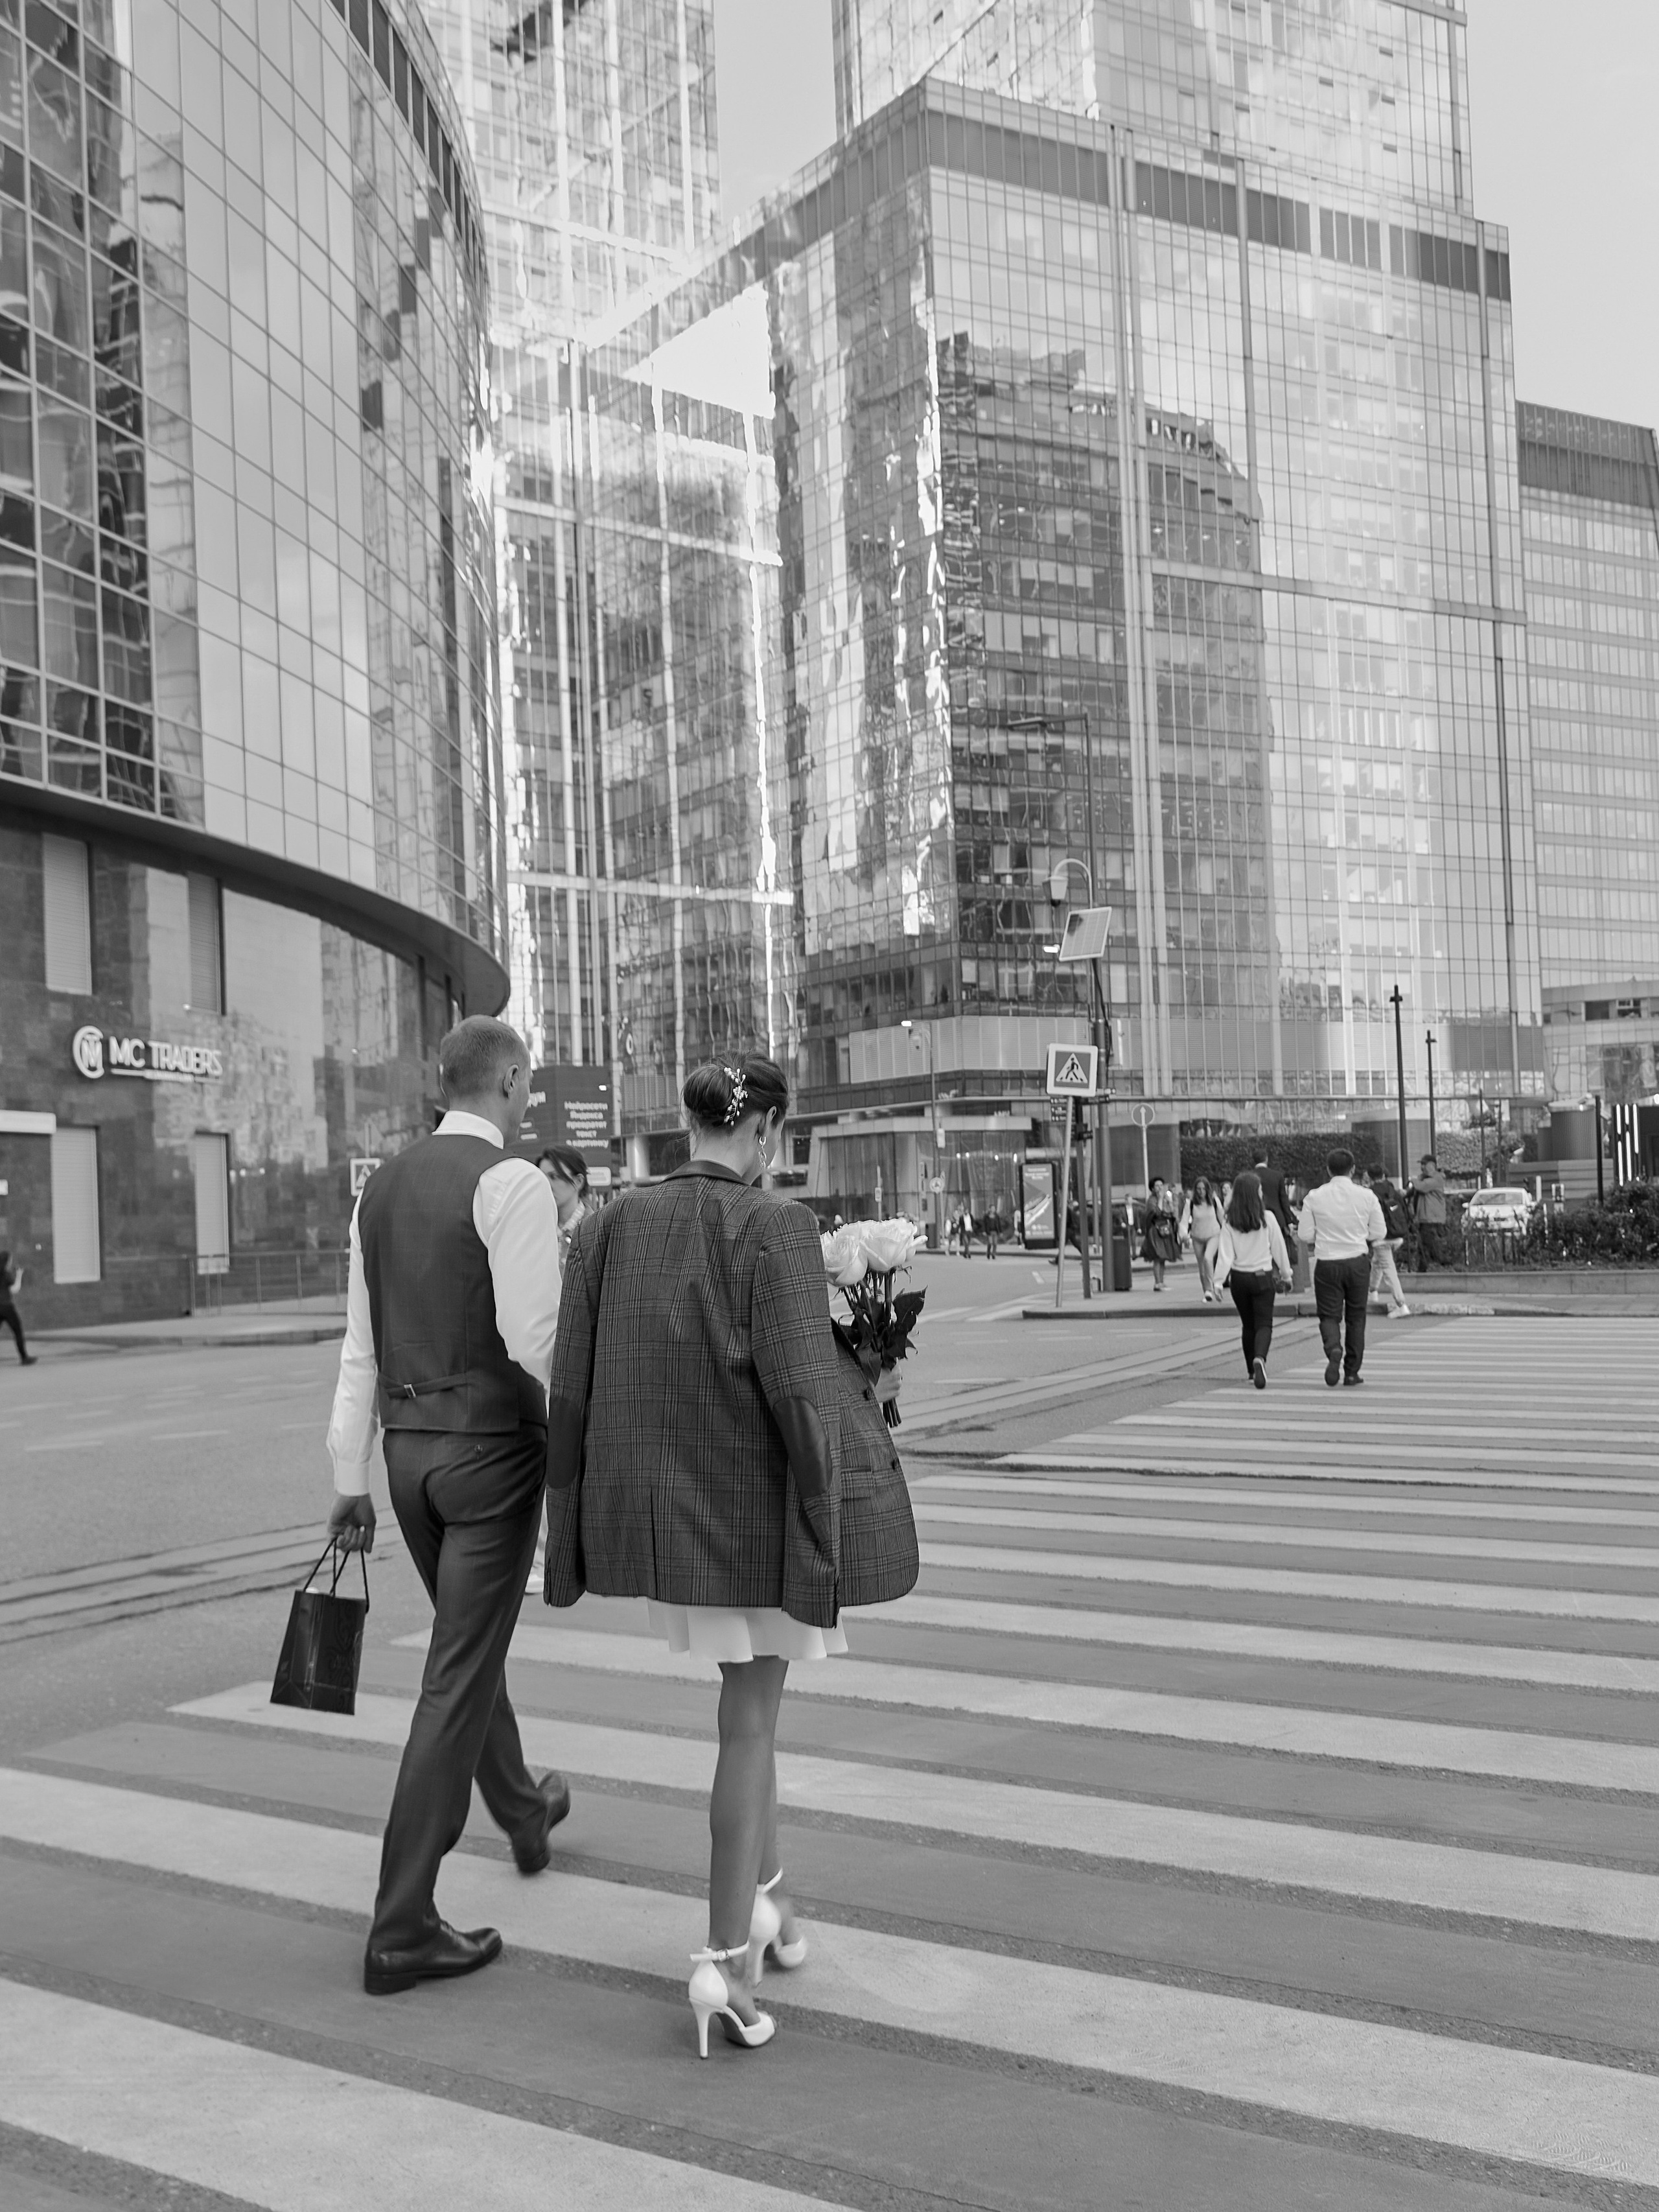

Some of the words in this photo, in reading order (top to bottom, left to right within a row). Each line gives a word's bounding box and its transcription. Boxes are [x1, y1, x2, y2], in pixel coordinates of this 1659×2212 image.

[109, 1036, 146, 1068] MC
[147, 1040, 223, 1075] TRADERS
[564, 1101, 608, 1110] Нейросети
[570, 1110, 603, 1119] Яндекса
[576, 1130, 597, 1138] текст
[572, 1139, 609, 1148] картинку
